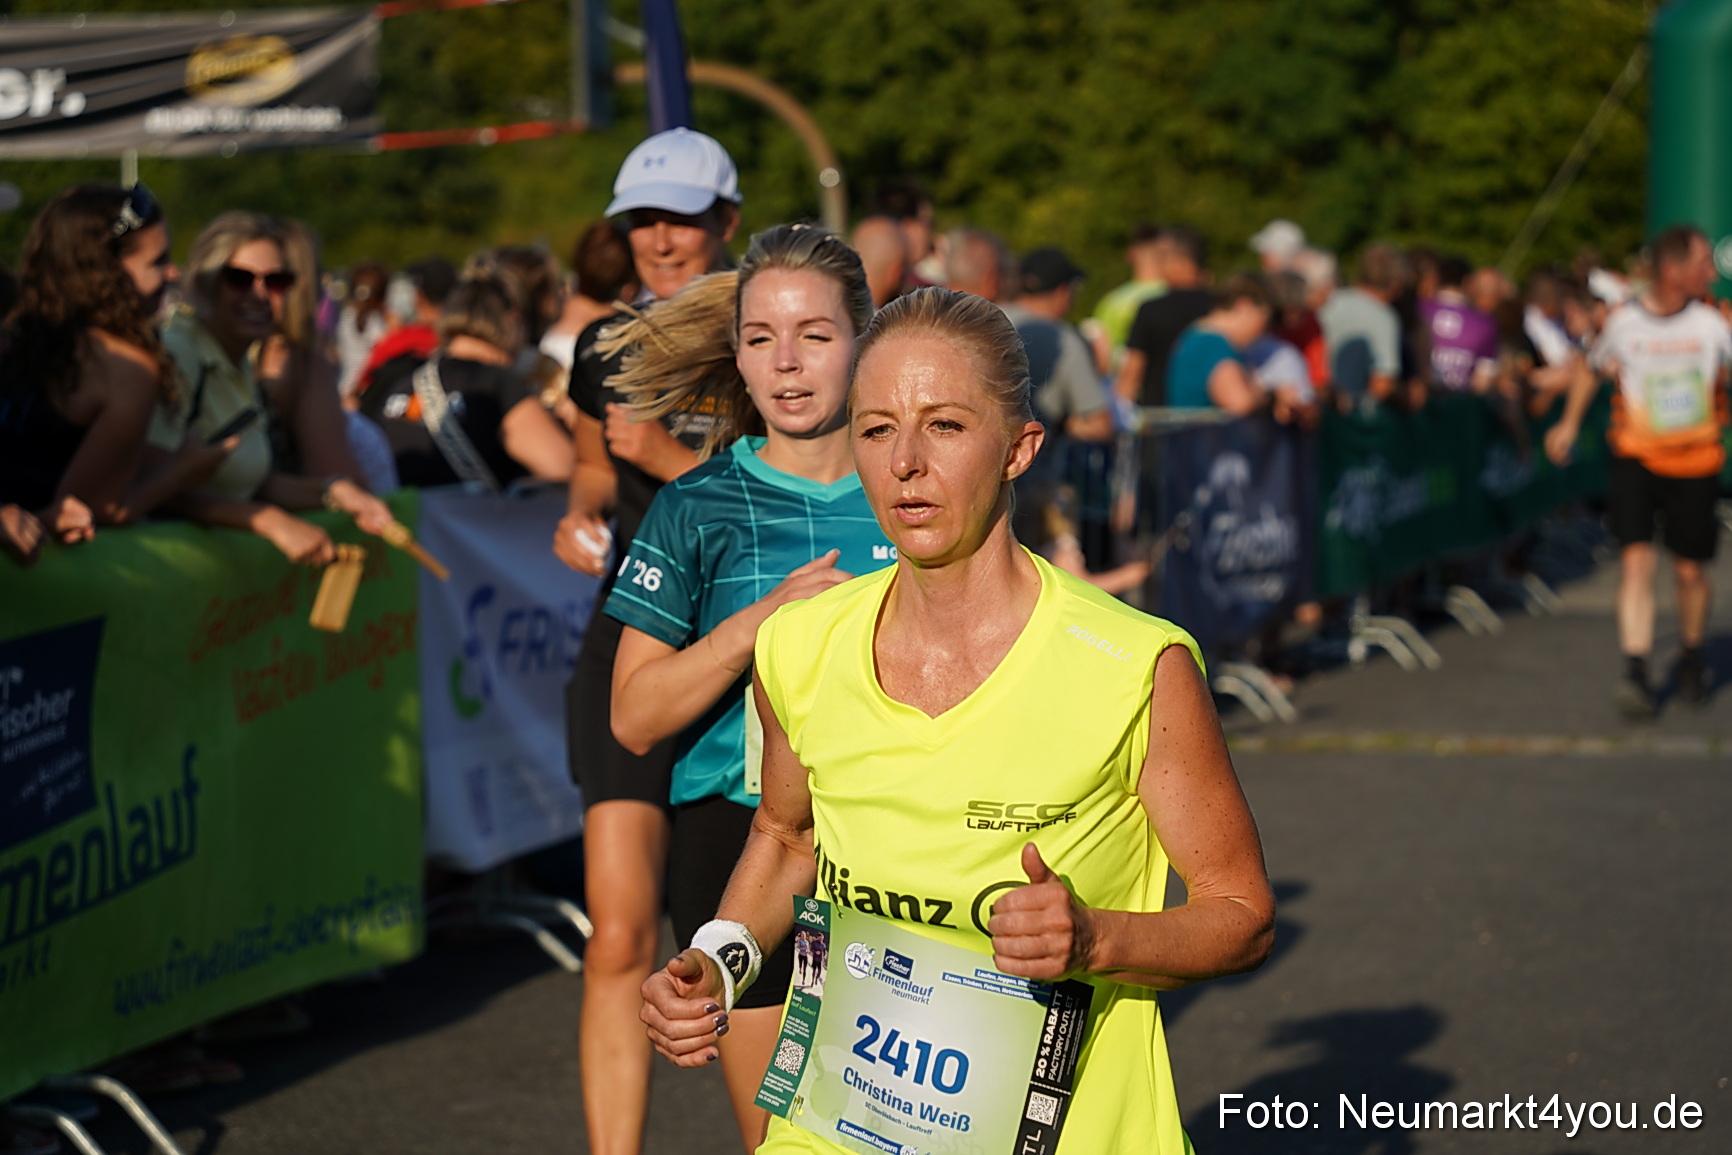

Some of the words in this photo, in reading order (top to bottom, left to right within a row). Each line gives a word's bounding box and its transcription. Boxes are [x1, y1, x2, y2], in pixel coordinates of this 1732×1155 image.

[499, 600, 598, 675] FRIS
[1066, 625, 1133, 661] ROGELLI
[0, 684, 75, 740] ischer
[814, 837, 957, 930] llianz
[799, 910, 825, 926] AOK
[872, 966, 934, 998] Firmenlauf
[891, 988, 930, 1006] neumarkt
[1043, 989, 1063, 1045] RABATT
[852, 1014, 970, 1095] 2410
[1040, 1045, 1051, 1057] %
[1048, 1034, 1065, 1081] FACTORY
[1059, 994, 1074, 1036] OUTLET
[1035, 1057, 1047, 1079] 20
[843, 1066, 914, 1116] Christina
[919, 1101, 971, 1132] Weiß
[839, 1121, 899, 1155] firmenlauf.bayern
[905, 1121, 933, 1136] Lauftreff
